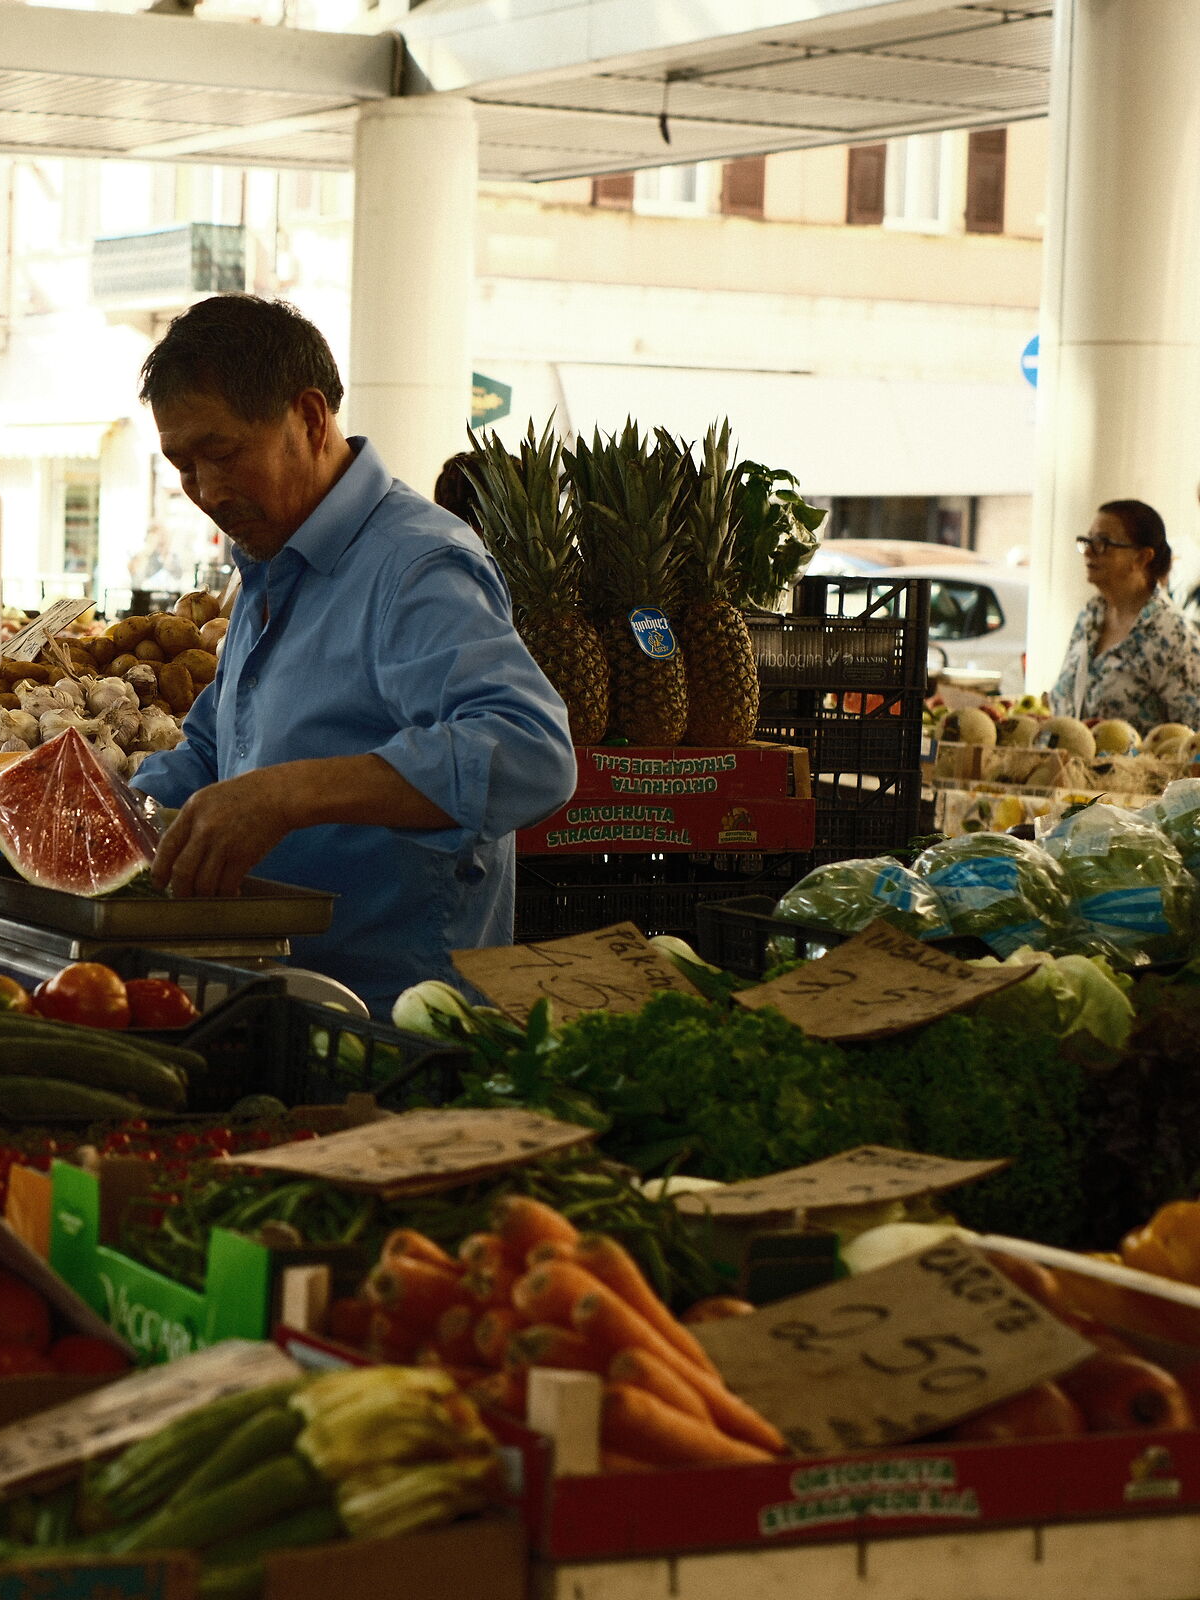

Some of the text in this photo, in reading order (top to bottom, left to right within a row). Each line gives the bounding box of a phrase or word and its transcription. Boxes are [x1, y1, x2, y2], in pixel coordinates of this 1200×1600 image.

[633, 754, 736, 775] STRAGAPEDE
[611, 775, 717, 794] ORTOFRUTTA
[567, 805, 675, 824] ORTOFRUTTA
[547, 826, 653, 847] STRAGAPEDE
